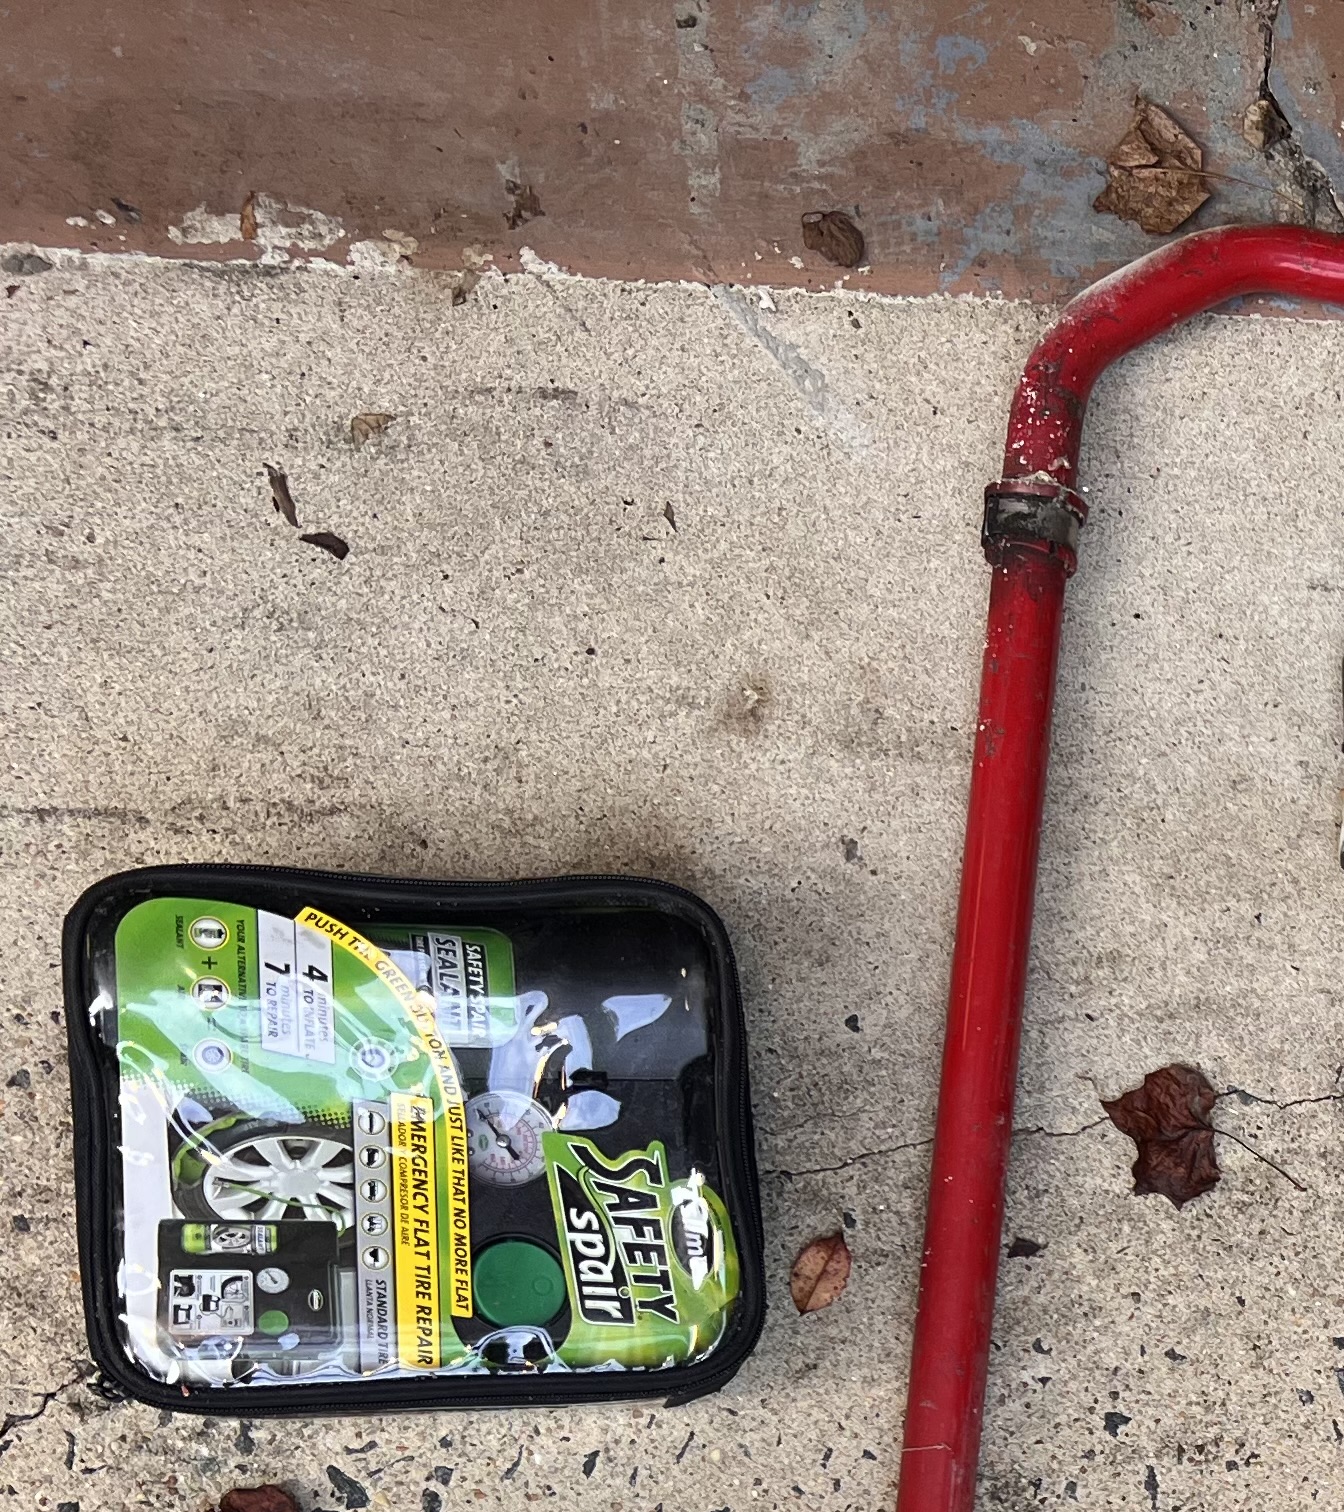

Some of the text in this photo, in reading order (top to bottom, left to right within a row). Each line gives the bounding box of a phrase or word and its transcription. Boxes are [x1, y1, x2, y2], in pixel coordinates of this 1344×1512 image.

[304, 912, 347, 940] PUSH
[264, 962, 290, 975] 7
[302, 964, 328, 982] 4
[374, 956, 417, 1002] GREEN
[435, 937, 462, 1030] SEALANT
[465, 944, 485, 994] SAFETY
[266, 981, 278, 1038] TO REPAIR
[303, 989, 314, 1004] TO
[438, 1064, 457, 1095] AND
[448, 1102, 464, 1133] JUST
[452, 1136, 464, 1165] LIKE
[398, 1156, 408, 1210] COMPRESOR
[452, 1169, 466, 1206] THAT
[400, 1212, 409, 1224] DE
[410, 1104, 434, 1365] EMERGENCY FLAT TIRE REPAIR
[454, 1208, 466, 1230] NO
[567, 1142, 680, 1324] SAFETY
[400, 1227, 410, 1246] AIRE
[454, 1234, 468, 1279] MORE
[569, 1207, 630, 1320] spair
[455, 1281, 469, 1312] FLAT
[376, 1279, 388, 1365] STANDARD TIRE
